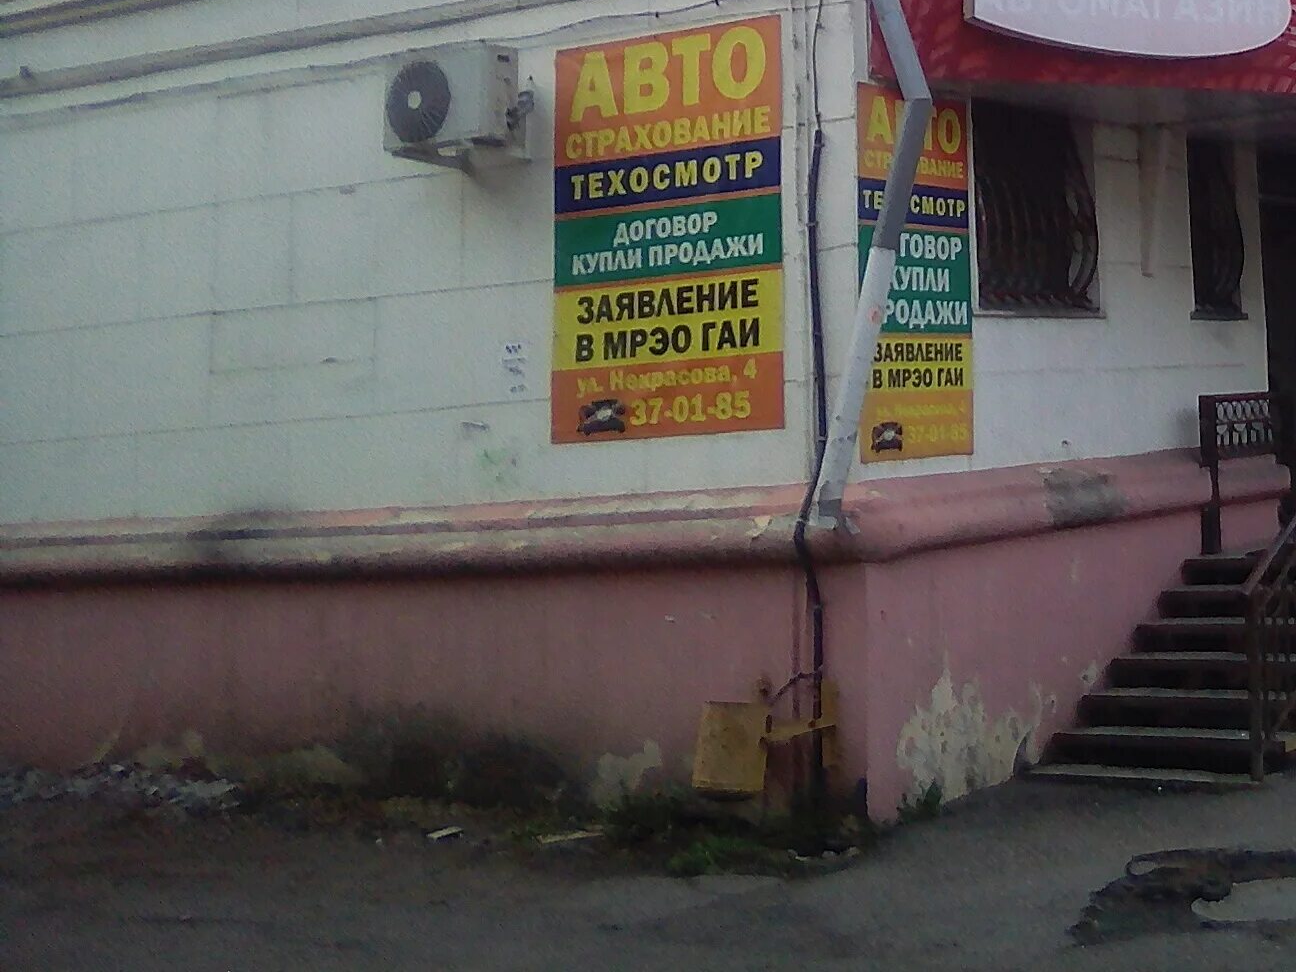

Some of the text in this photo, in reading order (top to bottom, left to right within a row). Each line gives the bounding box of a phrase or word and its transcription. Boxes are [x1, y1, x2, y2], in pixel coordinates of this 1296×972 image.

[569, 25, 767, 123] АВТО
[565, 104, 771, 160] СТРАХОВАНИЕ
[570, 149, 764, 201] ТЕХОСМОТР
[862, 189, 966, 218] ТЕСМОТР
[612, 211, 718, 248] ДОГОВОР
[900, 232, 963, 261] ГОВОР
[571, 233, 764, 276] КУПЛИ ПРОДАЖИ
[576, 278, 760, 325] ЗАЯВЛЕНИЕ
[883, 298, 968, 329] РОДАЖИ
[575, 317, 761, 364] В МРЭО ГАИ
[873, 342, 963, 363] ЗАЯВЛЕНИЕ
[743, 358, 758, 379] 4
[872, 368, 964, 389] В МРЭО ГАИ
[629, 390, 751, 426] 37-01-85
